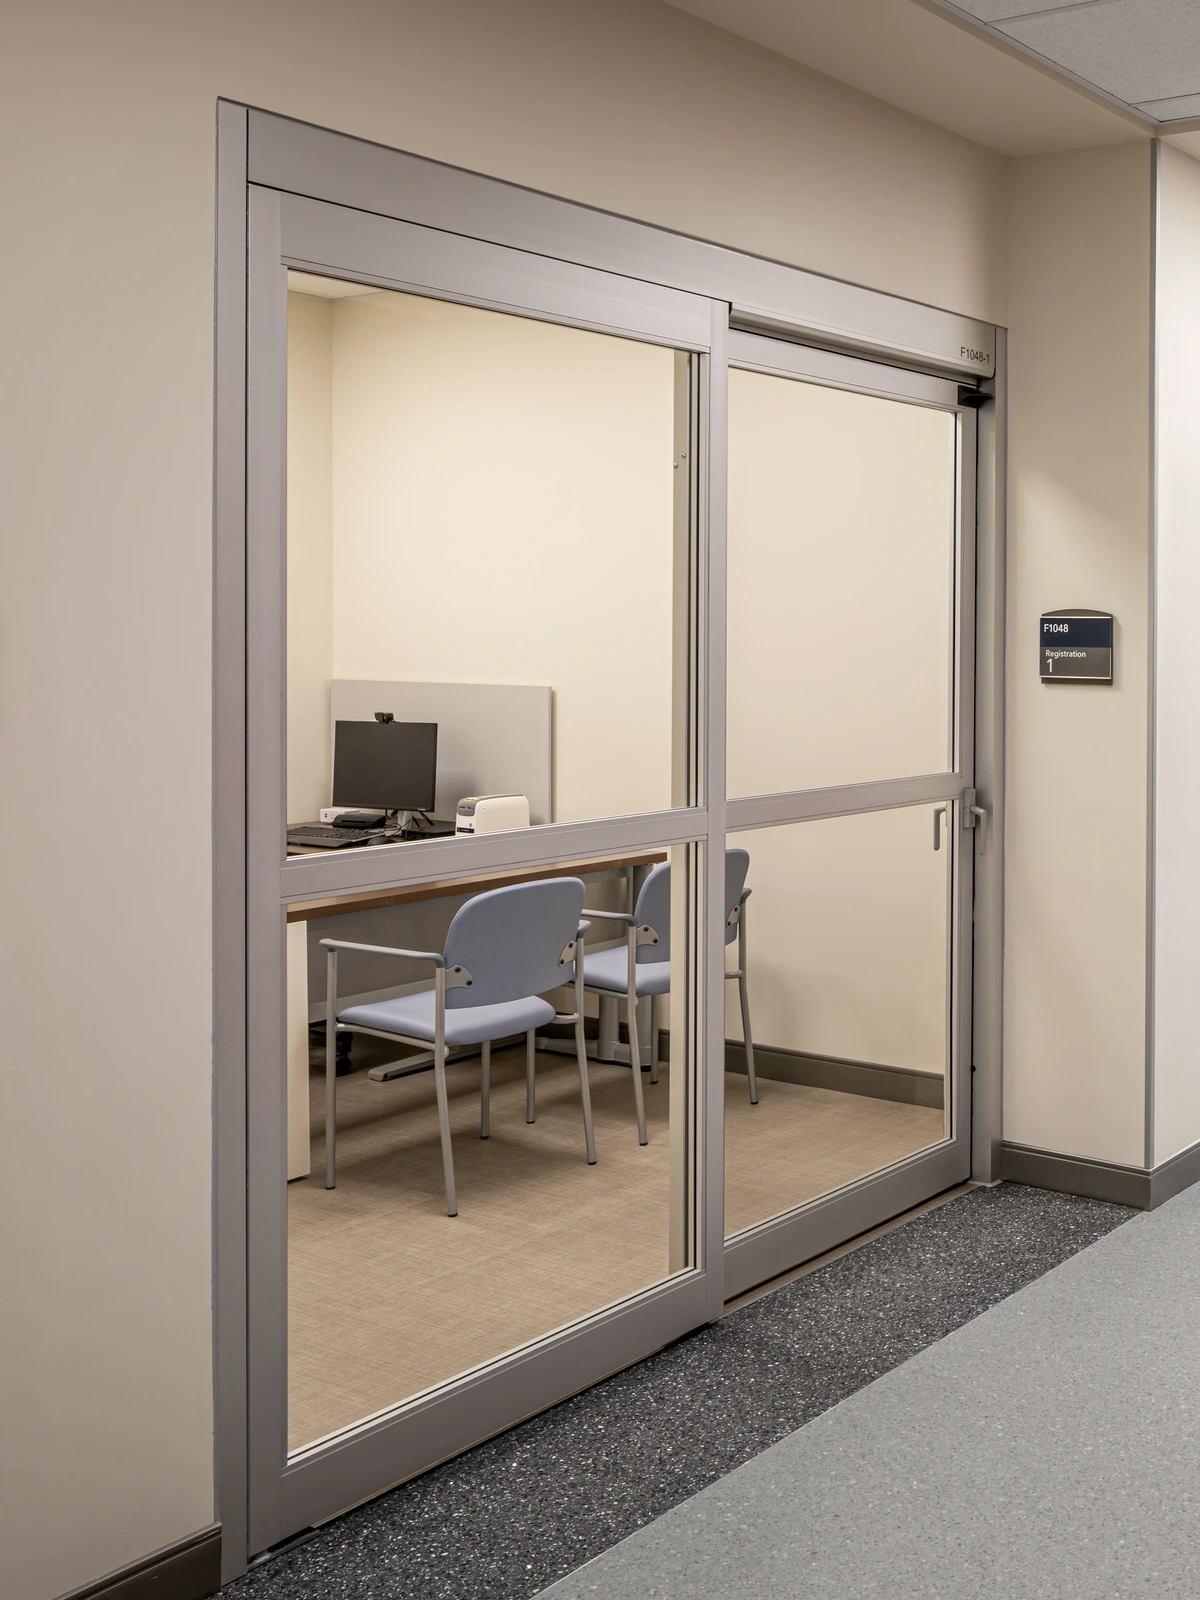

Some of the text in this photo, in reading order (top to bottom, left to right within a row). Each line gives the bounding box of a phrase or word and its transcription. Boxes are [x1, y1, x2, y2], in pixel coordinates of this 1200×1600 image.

[960, 346, 990, 364] F1048-1
[1043, 623, 1069, 633] F1048
[1045, 649, 1087, 659] Registration
[1046, 658, 1053, 673] 1
